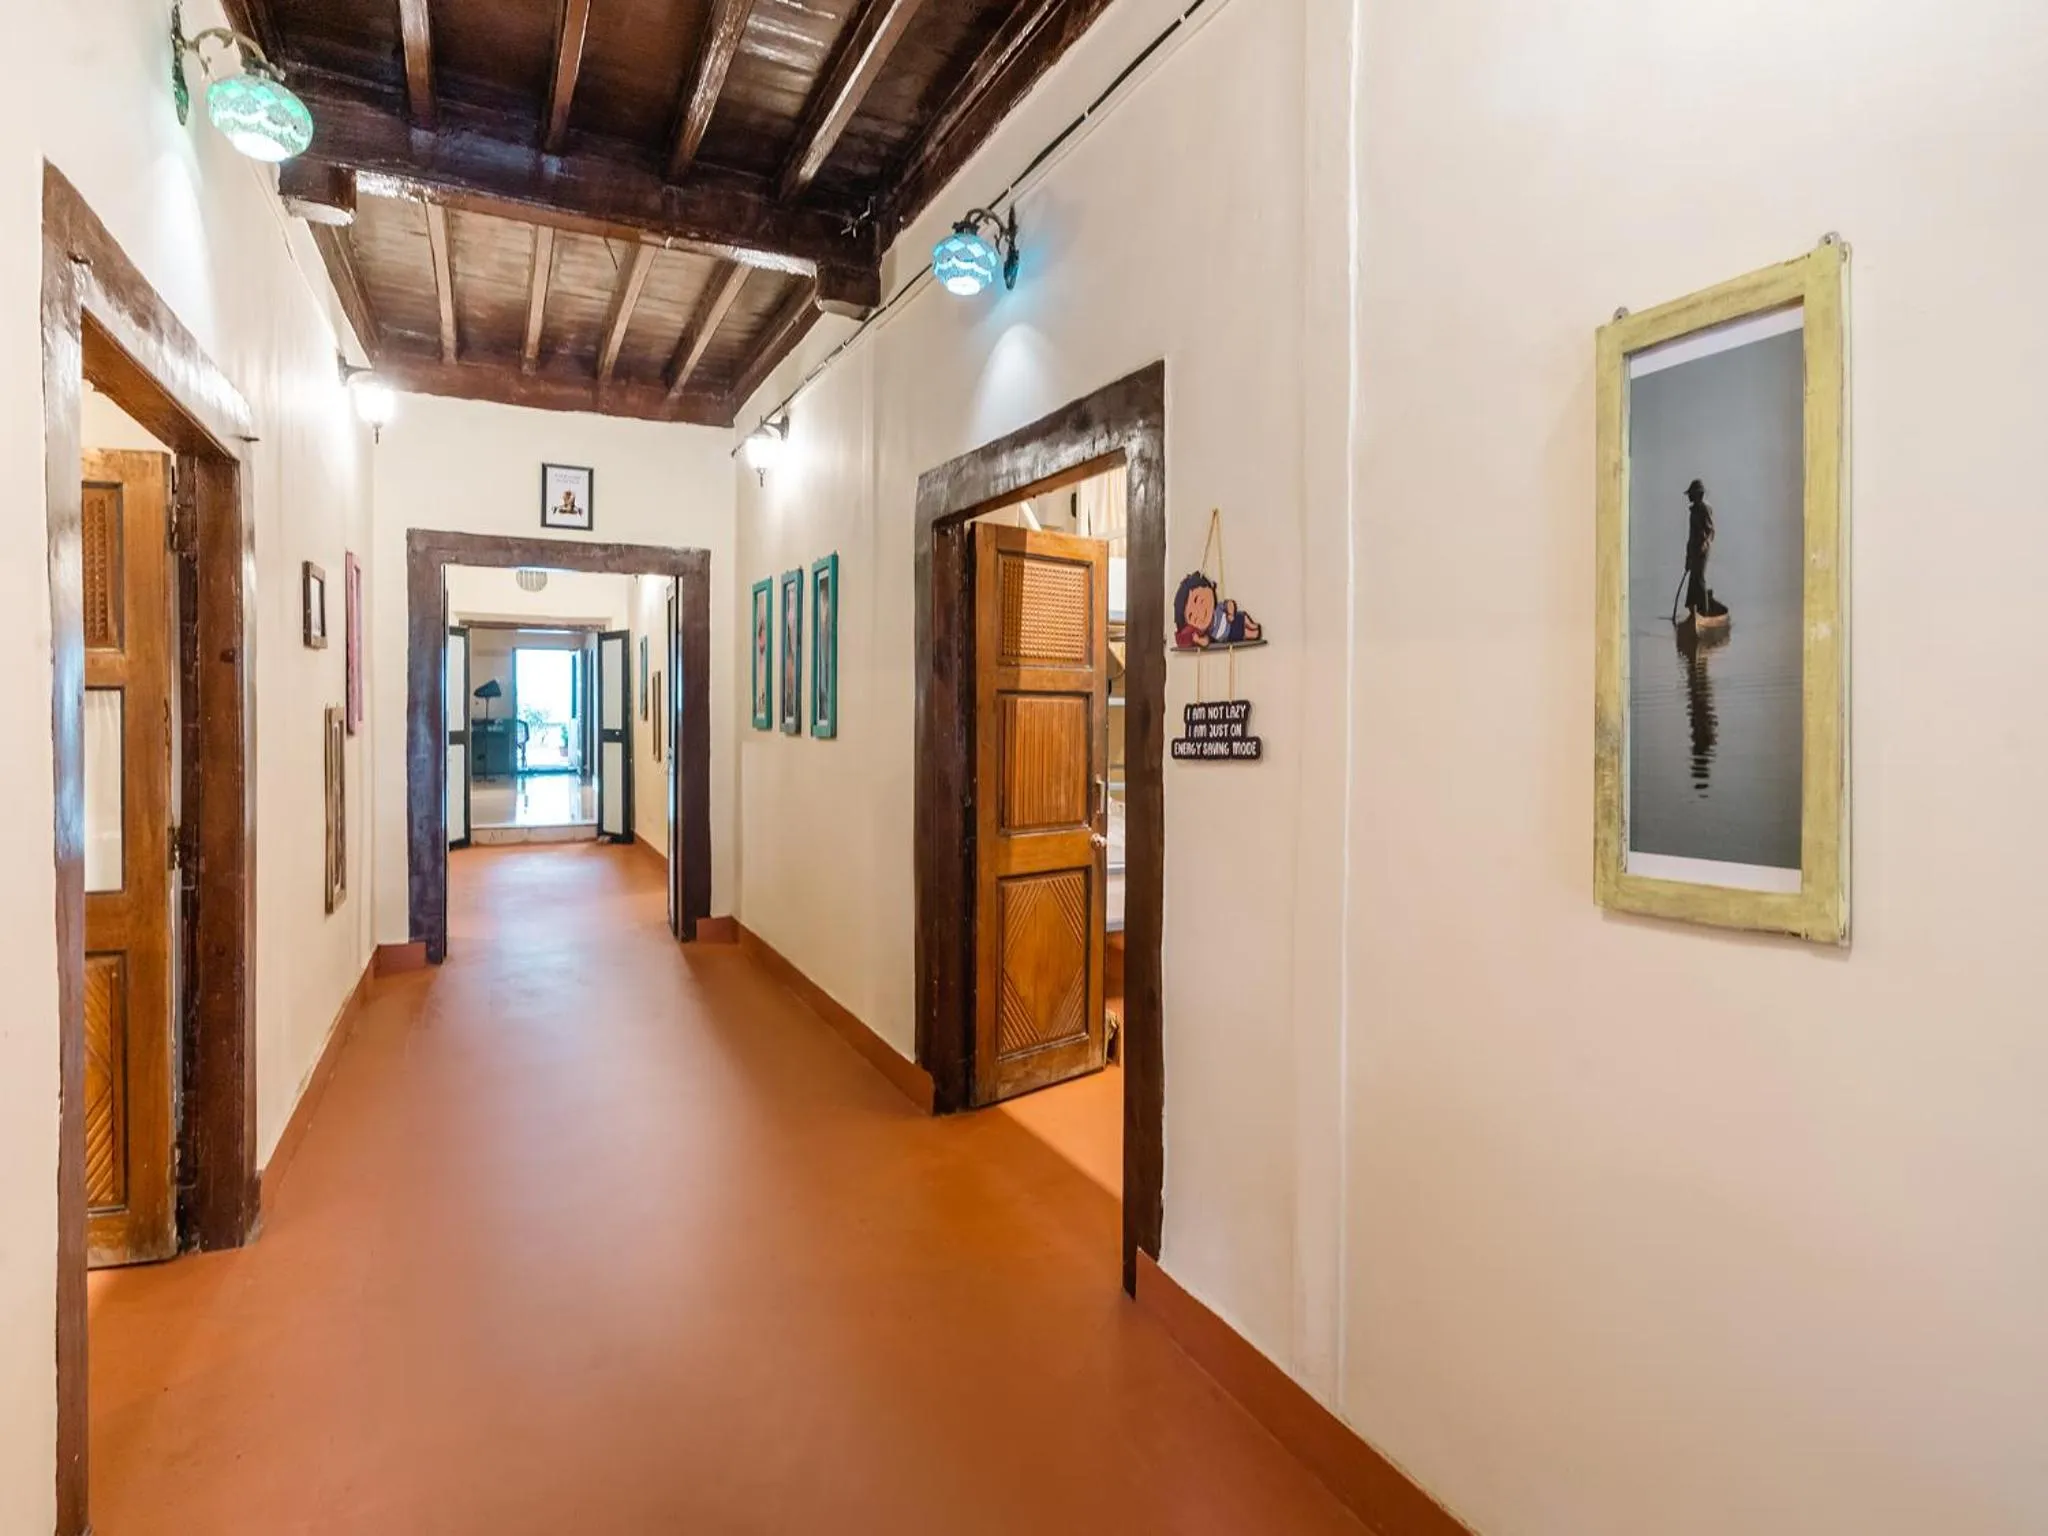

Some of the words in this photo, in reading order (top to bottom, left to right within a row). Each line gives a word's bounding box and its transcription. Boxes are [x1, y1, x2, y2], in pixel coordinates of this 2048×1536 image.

[1187, 708, 1190, 720] I
[1192, 707, 1206, 720] AM
[1208, 706, 1223, 720] NOT
[1226, 704, 1246, 718] LAZY
[1188, 725, 1191, 737] I
[1194, 725, 1207, 737] AM
[1210, 724, 1228, 737] JUST
[1230, 724, 1242, 736] ON
[1174, 742, 1202, 755] ENERGY
[1203, 742, 1229, 755] SAVING
[1232, 741, 1257, 755] MODE
